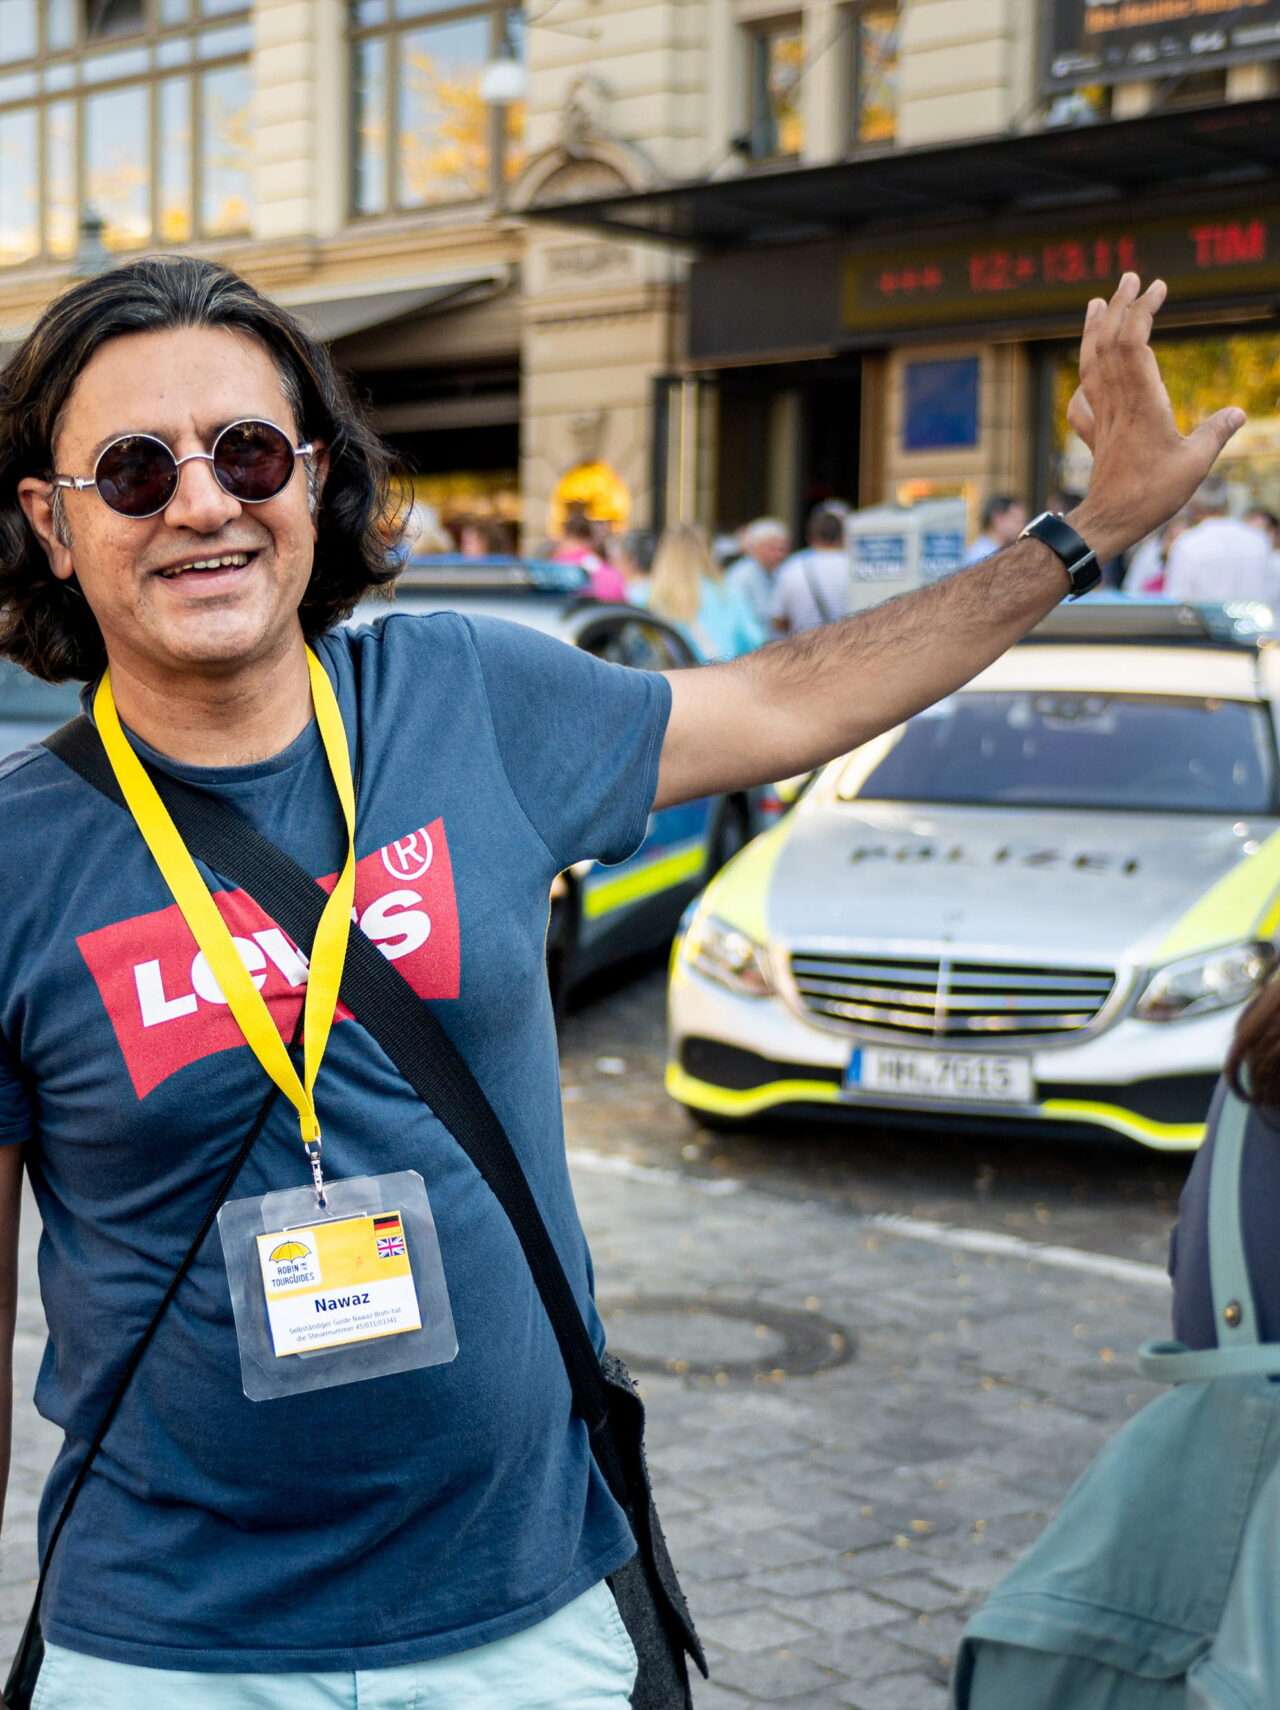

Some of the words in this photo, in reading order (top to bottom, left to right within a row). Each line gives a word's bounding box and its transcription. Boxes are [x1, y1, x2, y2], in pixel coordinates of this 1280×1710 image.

[849, 845, 1140, 877] POLIZEI
[277, 1264, 299, 1275] ROBIN
[272, 1272, 315, 1288] TOURGUIDES
[314, 1292, 370, 1313] Nawaz
